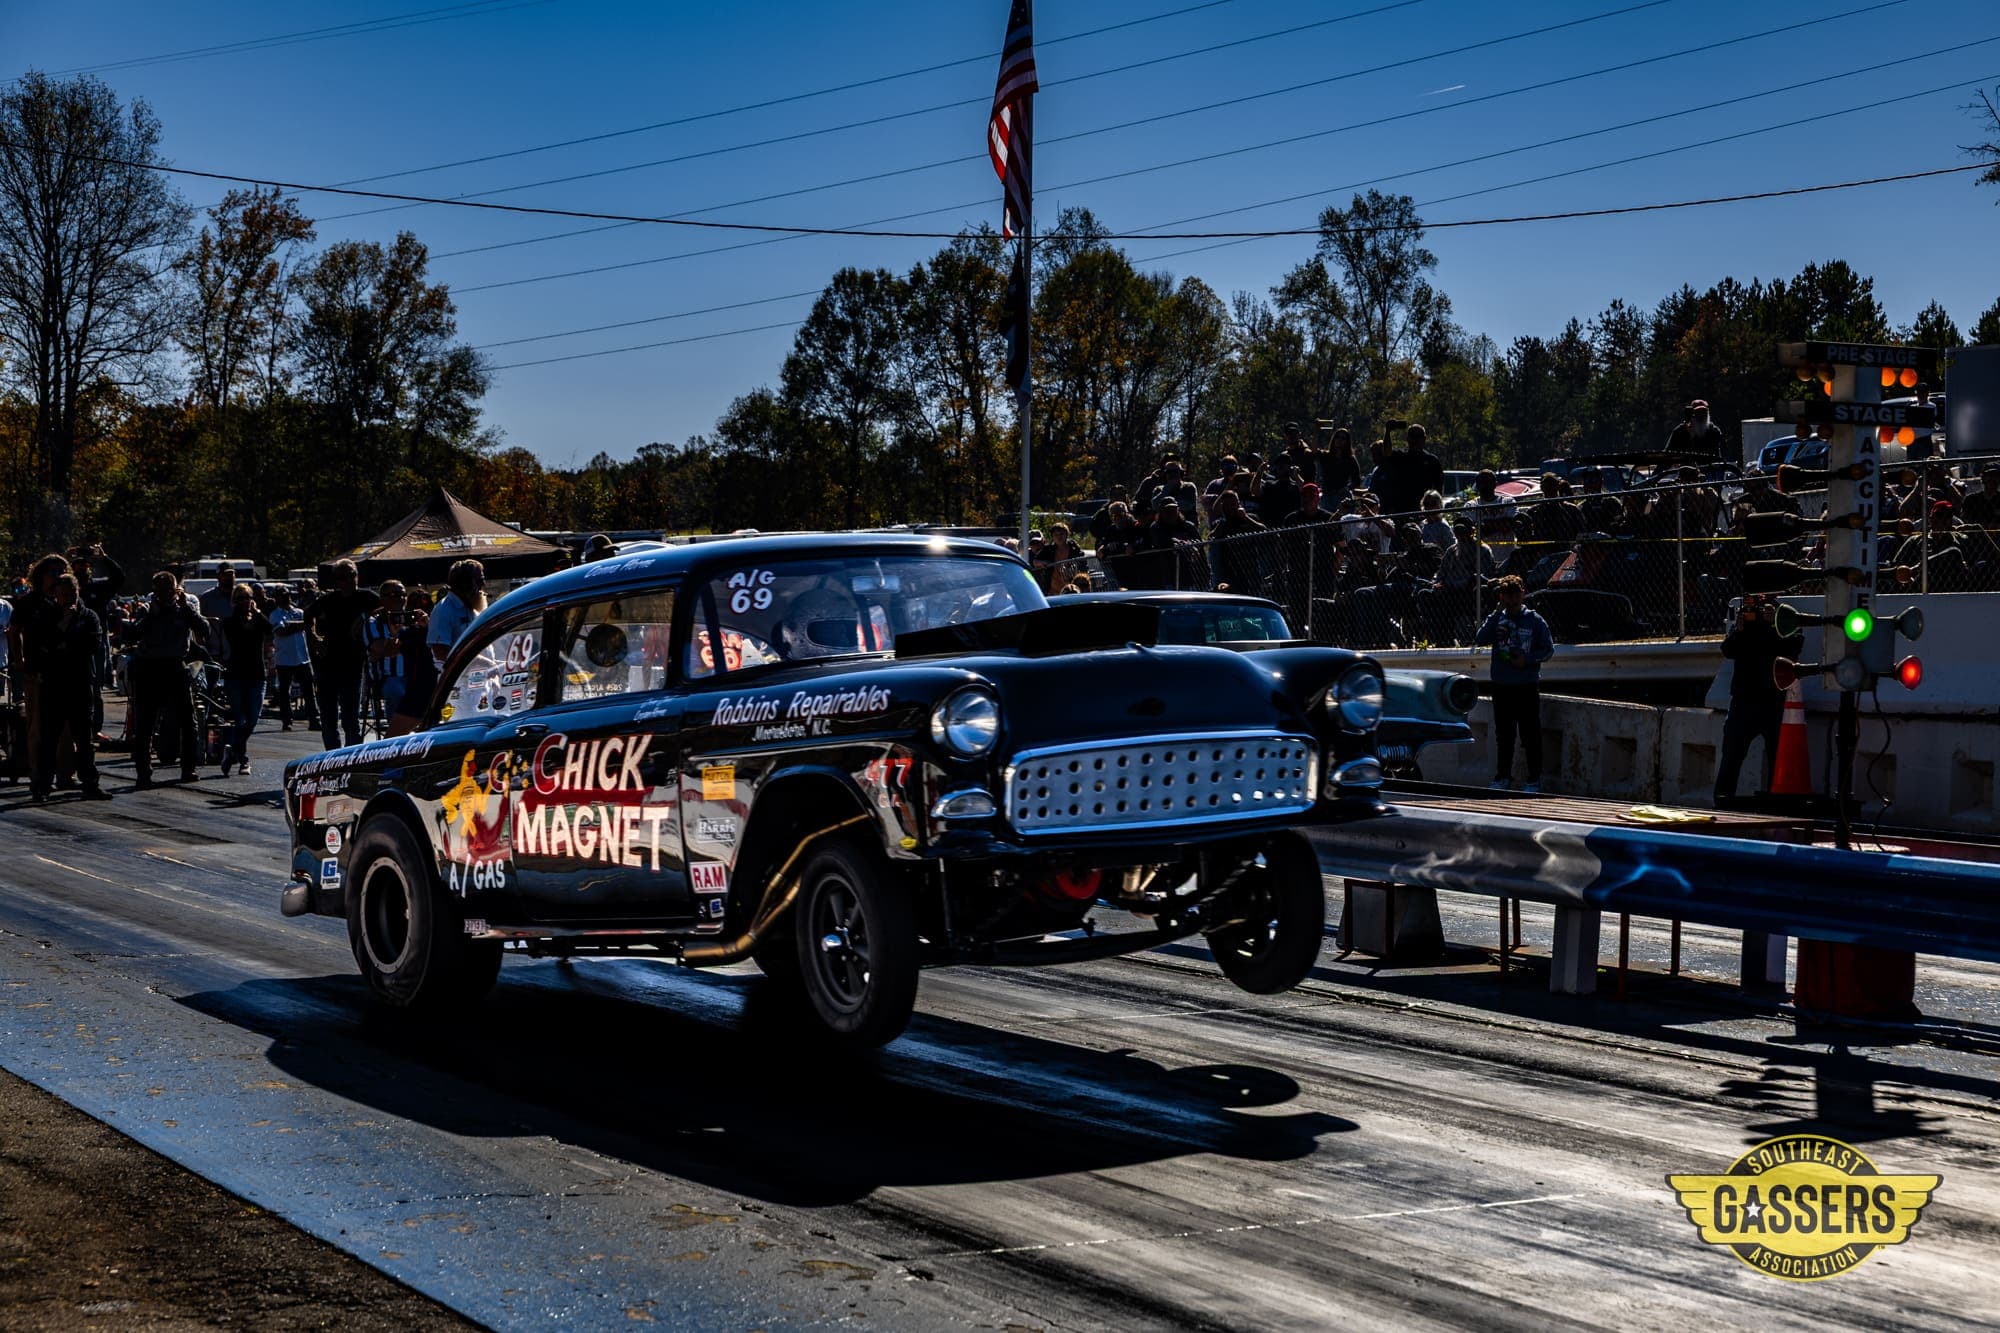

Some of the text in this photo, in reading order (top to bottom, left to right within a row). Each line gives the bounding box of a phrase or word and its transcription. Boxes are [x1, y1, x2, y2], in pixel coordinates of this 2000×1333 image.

[1835, 404, 1907, 423] STAGE
[728, 569, 776, 590] A/G
[730, 587, 774, 614] 69
[506, 633, 533, 672] 69
[711, 685, 892, 726] Robbins Repairables
[532, 733, 653, 795] CHICK
[517, 801, 670, 873] MAGNET
[692, 866, 726, 889] RAM
